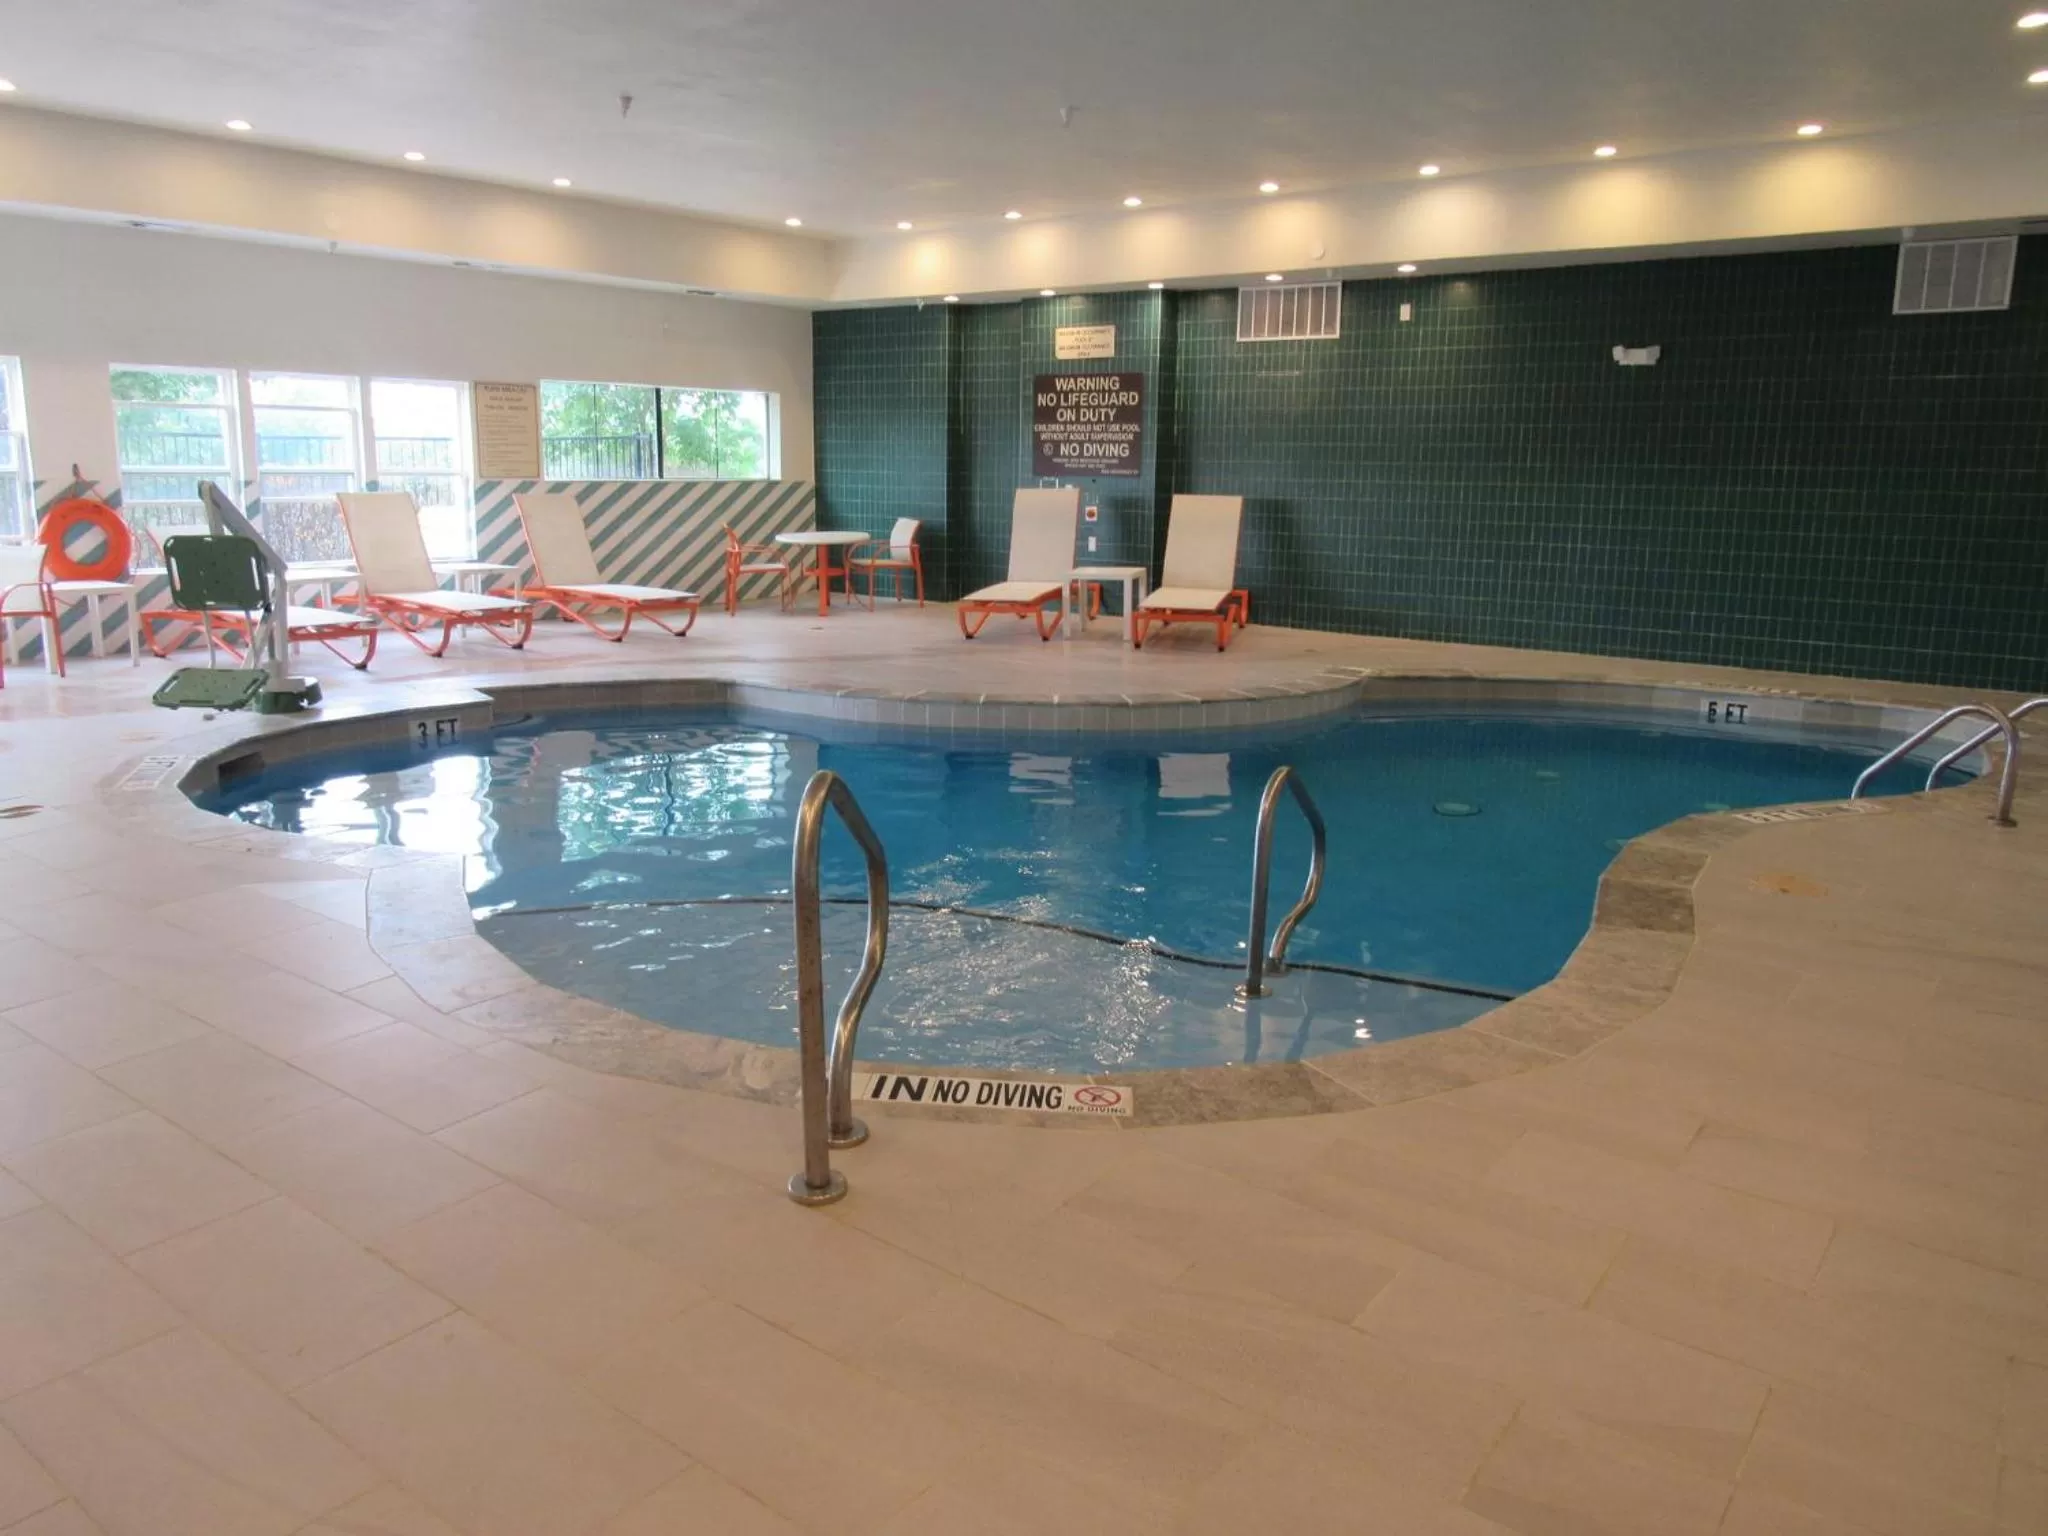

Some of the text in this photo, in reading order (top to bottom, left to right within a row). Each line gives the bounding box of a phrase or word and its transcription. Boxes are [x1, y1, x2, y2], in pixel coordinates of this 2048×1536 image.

[1055, 376, 1120, 391] WARNING
[1037, 391, 1139, 407] NO LIFEGUARD
[1056, 407, 1117, 422] ON DUTY
[1121, 423, 1140, 432] POOL
[1060, 442, 1130, 457] NO DIVING
[1724, 702, 1749, 723] FT
[435, 718, 458, 736] FT
[871, 1075, 1063, 1110] IN NO DIVING
[1087, 1105, 1127, 1114] DIVING
